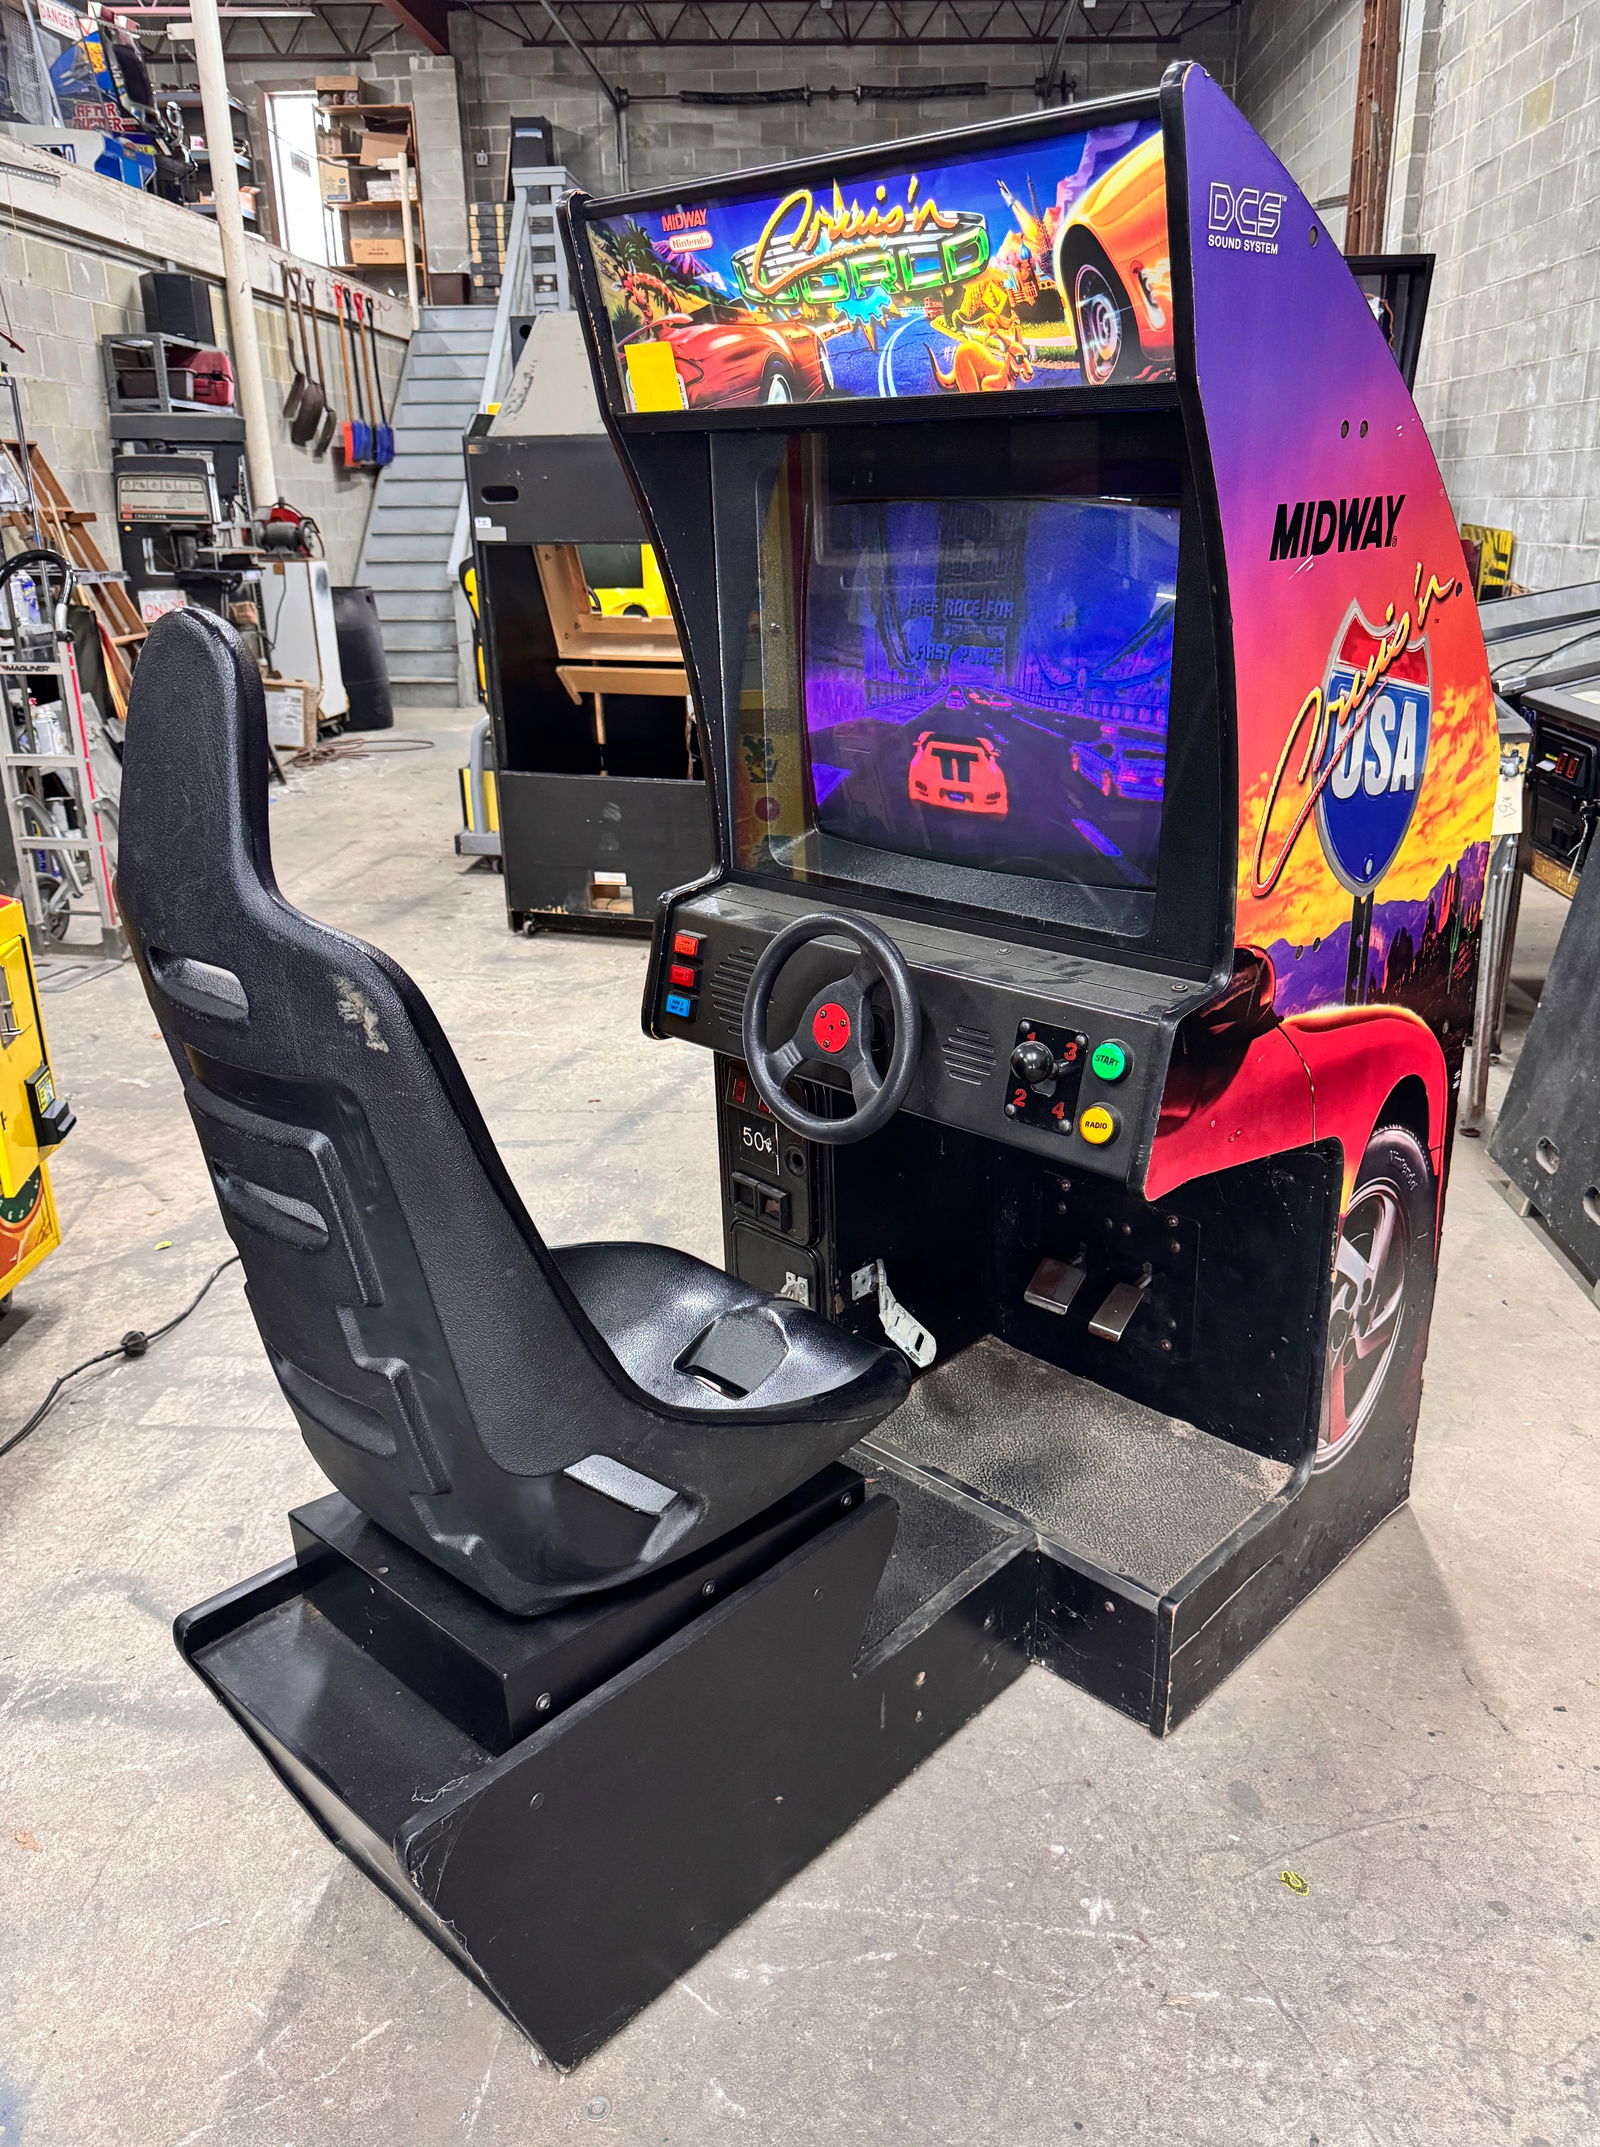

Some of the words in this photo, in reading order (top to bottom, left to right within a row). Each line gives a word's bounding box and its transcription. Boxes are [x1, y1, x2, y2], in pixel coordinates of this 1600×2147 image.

[40, 3, 76, 32] DANGER
[661, 207, 707, 232] MIDWAY
[1208, 182, 1282, 238] DCS
[672, 235, 710, 249] Nintendo
[752, 175, 959, 296] Cruis'n
[1208, 234, 1241, 250] SOUND
[1243, 239, 1279, 255] SYSTEM
[731, 226, 990, 305] WORLD
[1269, 494, 1406, 561] MIDWAY
[944, 598, 982, 618] RACE
[985, 599, 1015, 619] FOR
[915, 643, 953, 663] FIRST
[1329, 687, 1418, 800] USA
[1063, 1042, 1078, 1061] 3
[1094, 1054, 1120, 1068] START
[1012, 1088, 1027, 1107] 2
[1051, 1101, 1065, 1120] 4
[1084, 1121, 1108, 1130] RADIO
